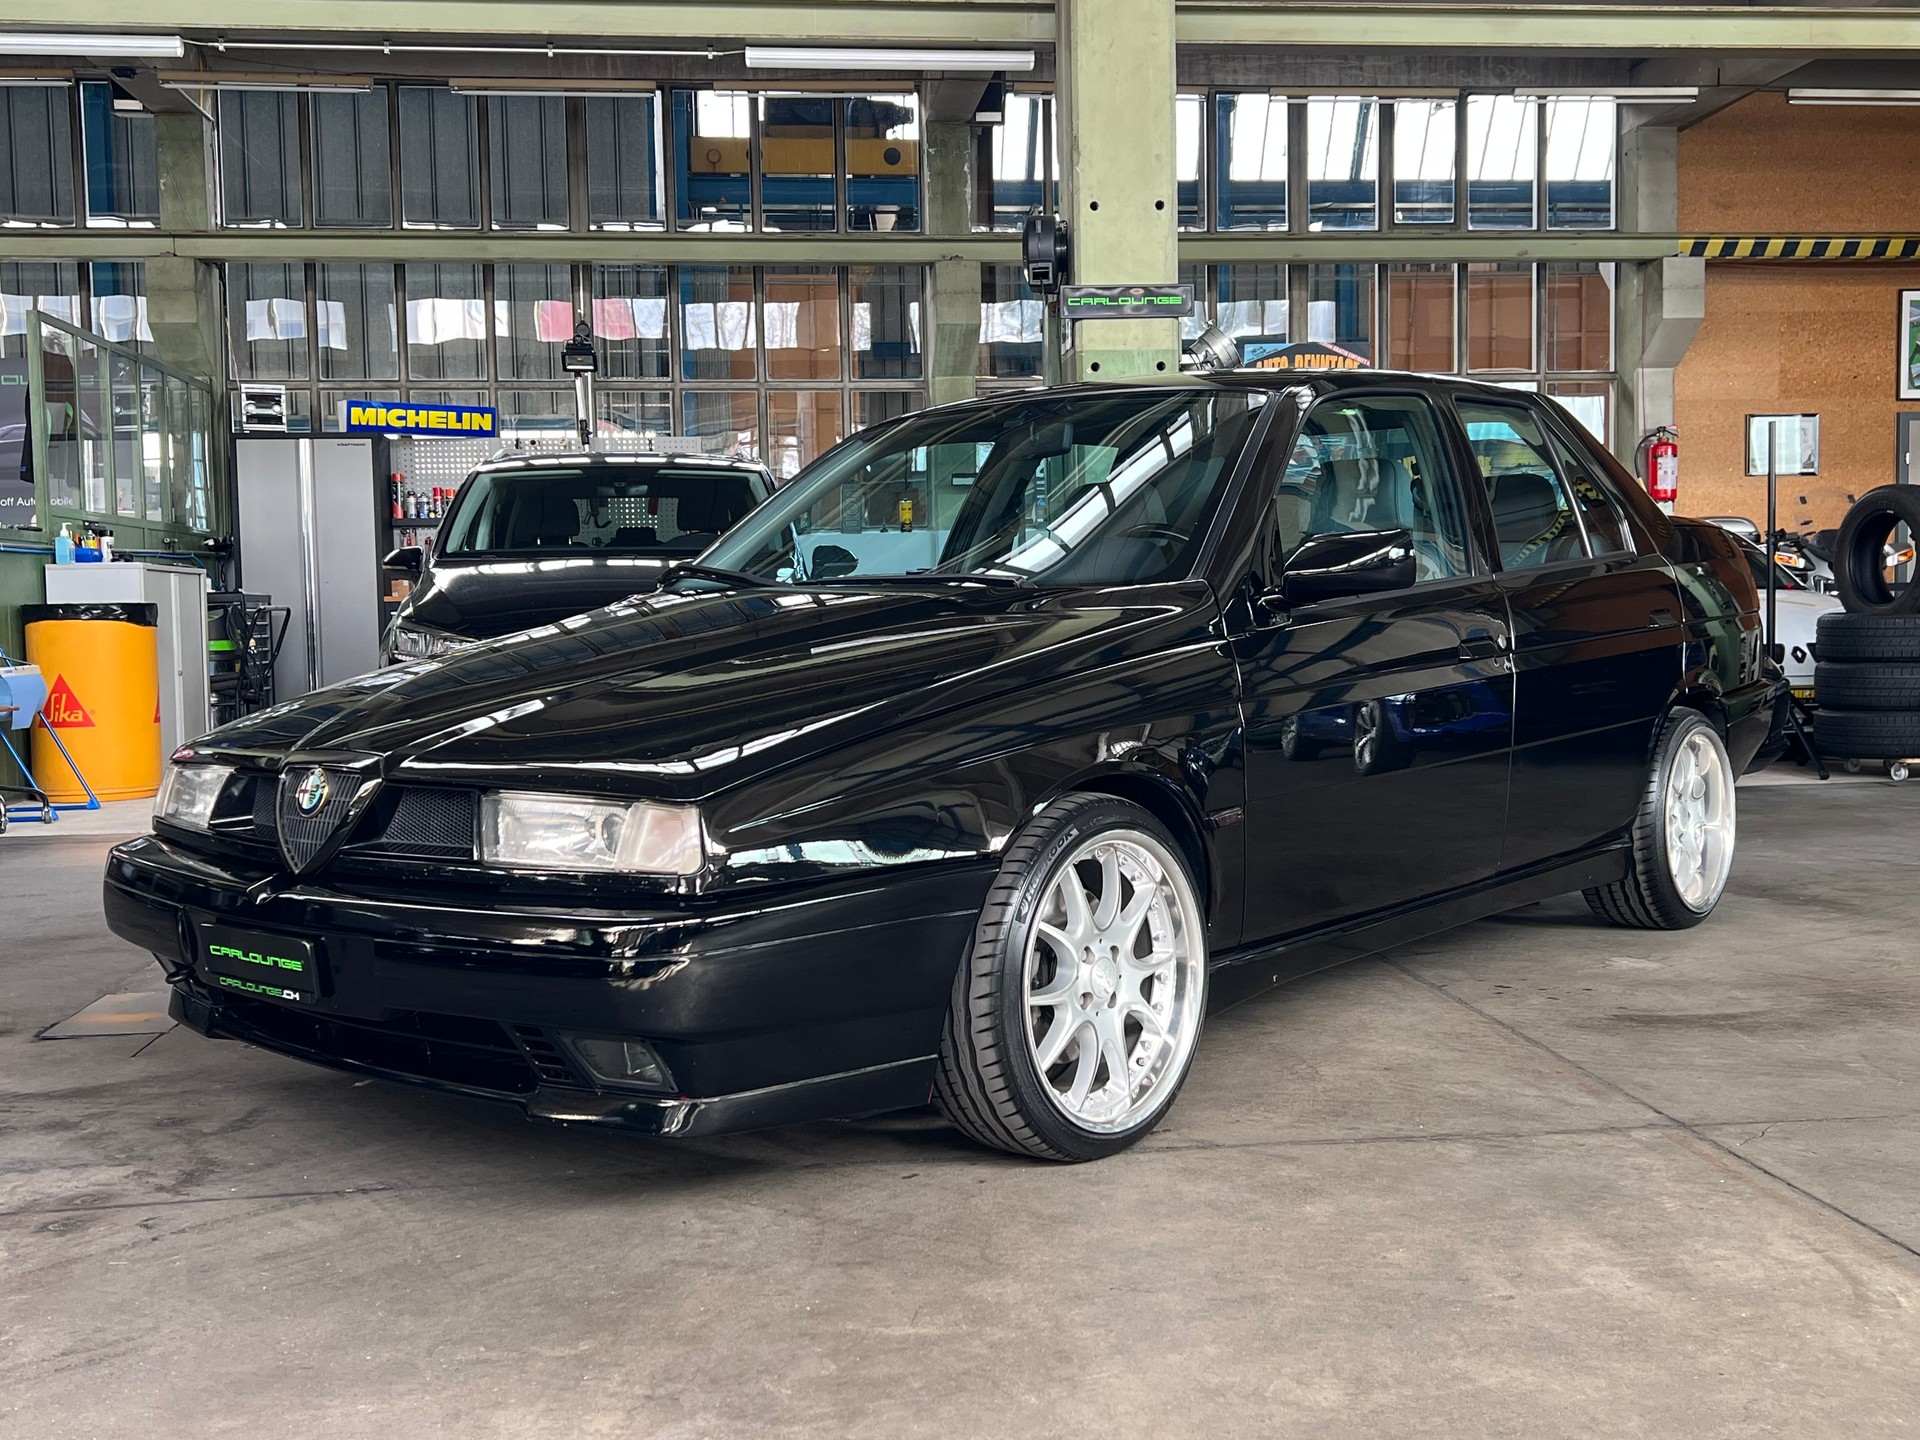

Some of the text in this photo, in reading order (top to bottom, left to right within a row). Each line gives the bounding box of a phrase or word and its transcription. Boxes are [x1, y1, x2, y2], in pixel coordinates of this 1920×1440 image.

[1068, 296, 1183, 306] CARLOUNGE
[350, 407, 493, 431] MICHELIN
[0, 497, 14, 507] off
[48, 693, 84, 723] Sika
[209, 944, 303, 972] CARLOUNGE
